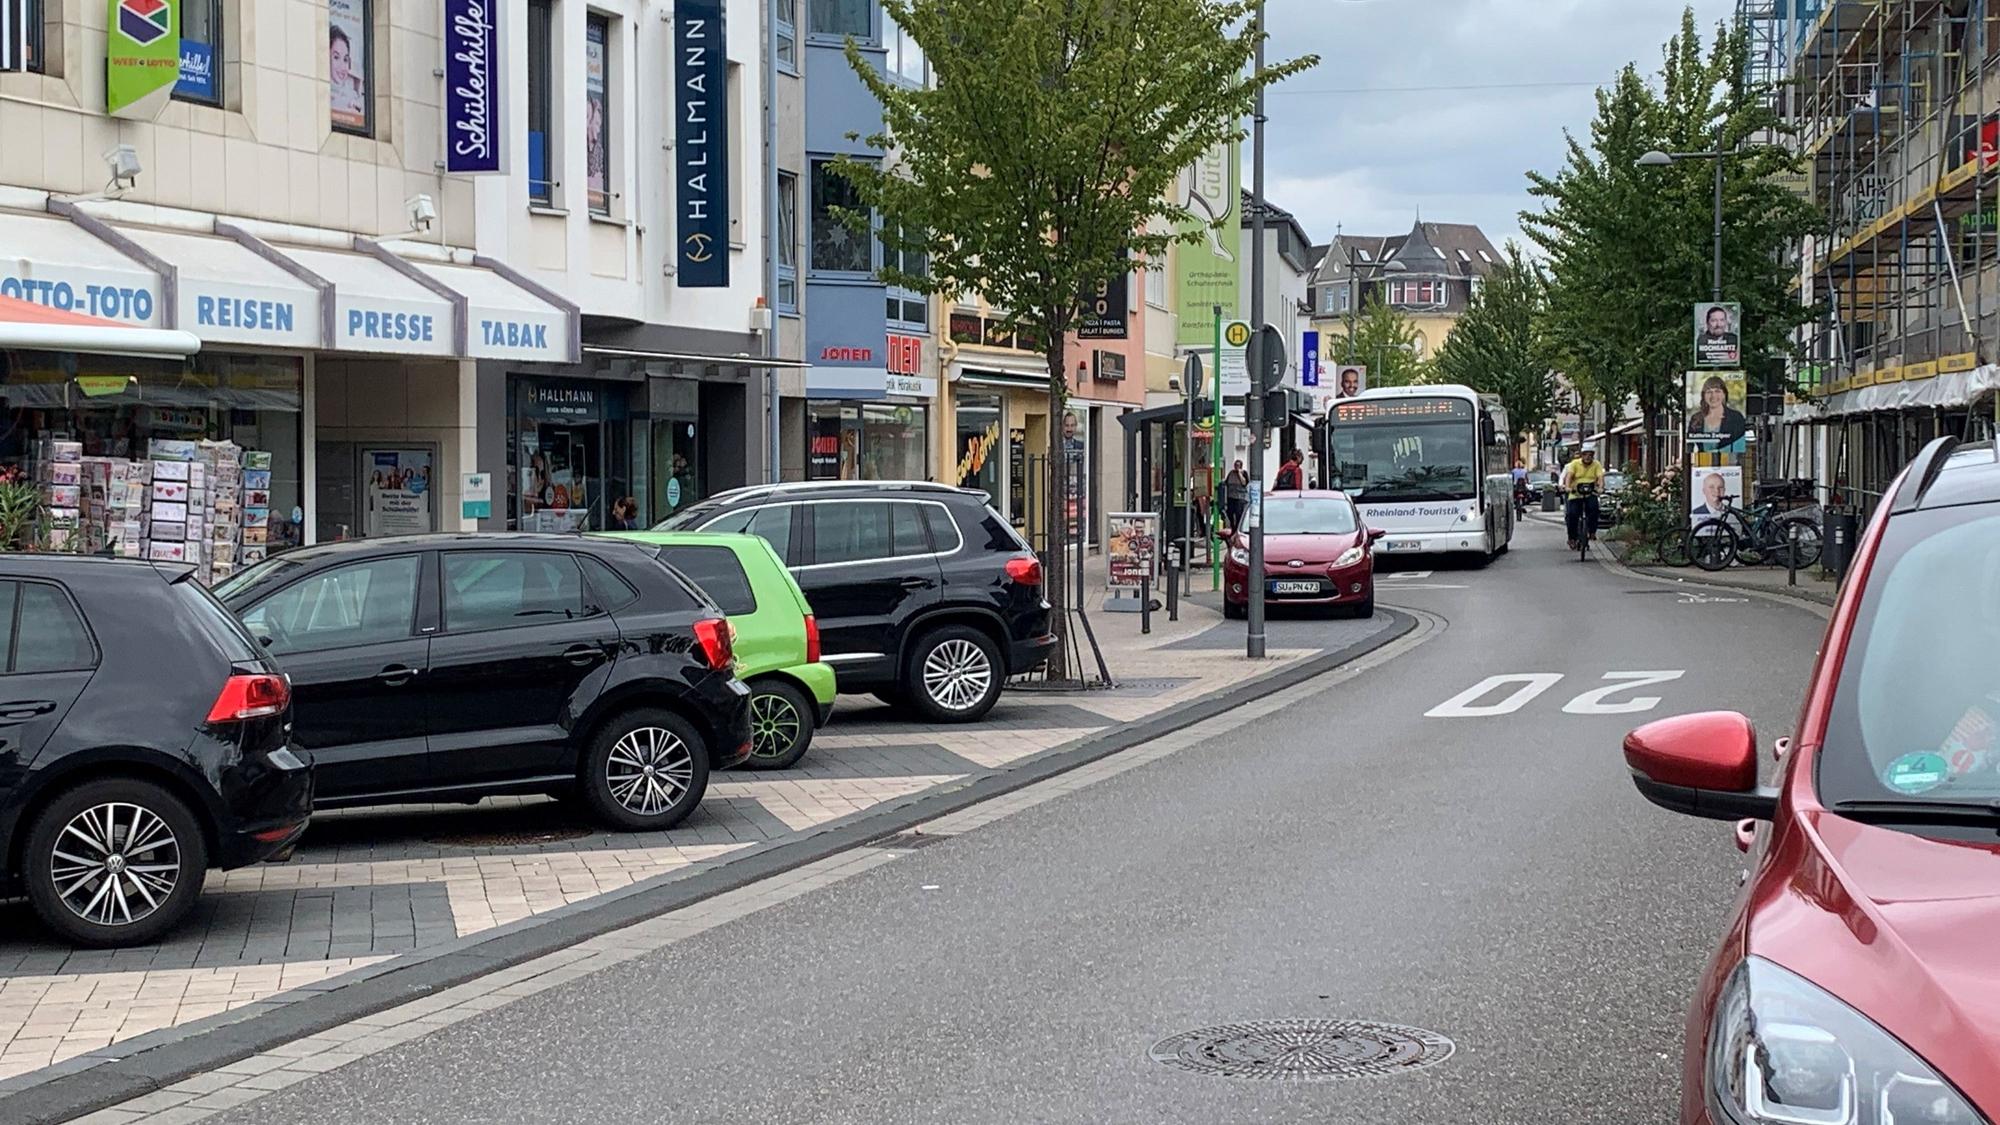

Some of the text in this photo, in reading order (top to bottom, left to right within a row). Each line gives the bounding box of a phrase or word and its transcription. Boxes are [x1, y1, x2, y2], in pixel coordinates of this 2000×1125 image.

[455, 0, 493, 158] Schülerhilfe
[686, 19, 707, 219] HALLMANN
[1962, 212, 1998, 228] Apoth
[197, 295, 293, 331] REISEN
[348, 309, 432, 341] PRESSE
[482, 320, 547, 348] TABAK
[1232, 327, 1243, 341] H
[821, 347, 872, 361] JONEN
[886, 335, 921, 374] NEN
[540, 388, 594, 403] HALLMANN
[1366, 507, 1460, 518] Rheinland-Touristik
[1304, 583, 1319, 591] 473
